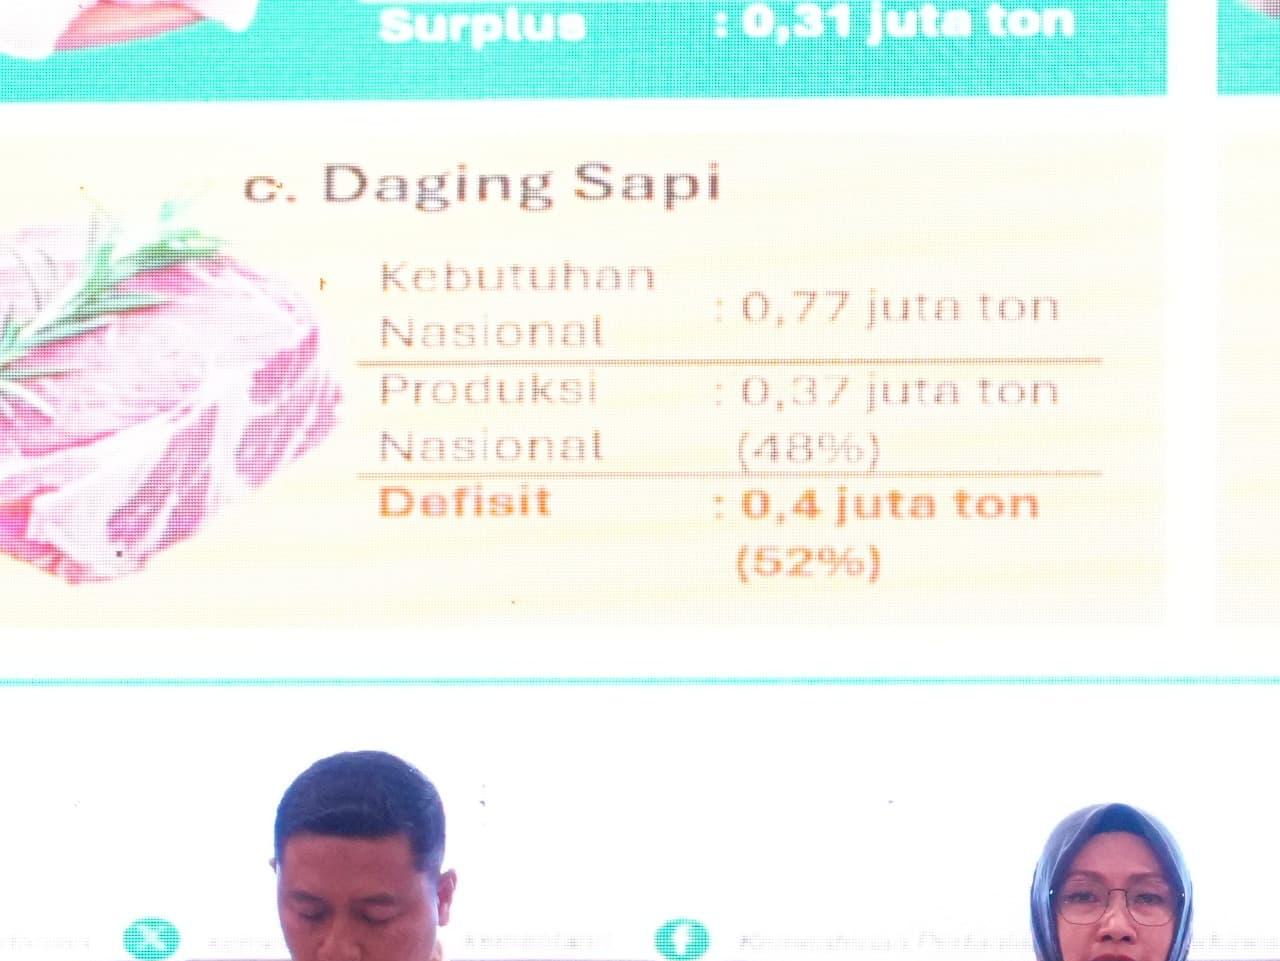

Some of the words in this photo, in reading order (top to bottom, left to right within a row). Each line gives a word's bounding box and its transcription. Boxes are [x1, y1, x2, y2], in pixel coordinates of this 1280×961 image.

[379, 7, 587, 51] Surplus
[742, 2, 853, 45] 0,31
[866, 0, 973, 47] juta
[985, 2, 1076, 37] ton
[244, 175, 297, 203] c.
[324, 163, 554, 213] Daging
[574, 163, 719, 211] Sapi
[381, 260, 655, 295] Kebutuhan
[741, 289, 850, 329] 0,77
[865, 287, 961, 331] juta
[979, 293, 1060, 321] ton
[380, 314, 603, 350] Nasional
[380, 372, 597, 406] Produksi
[740, 375, 851, 412] 0,37
[866, 370, 960, 414] juta
[977, 376, 1059, 406] ton
[380, 429, 604, 464] Nasional
[737, 430, 880, 471] (48%)
[379, 486, 550, 518] Defisit
[741, 489, 822, 524] 0,4
[836, 484, 936, 528] juta
[953, 489, 1039, 518] ton
[736, 545, 881, 586] (52%)
